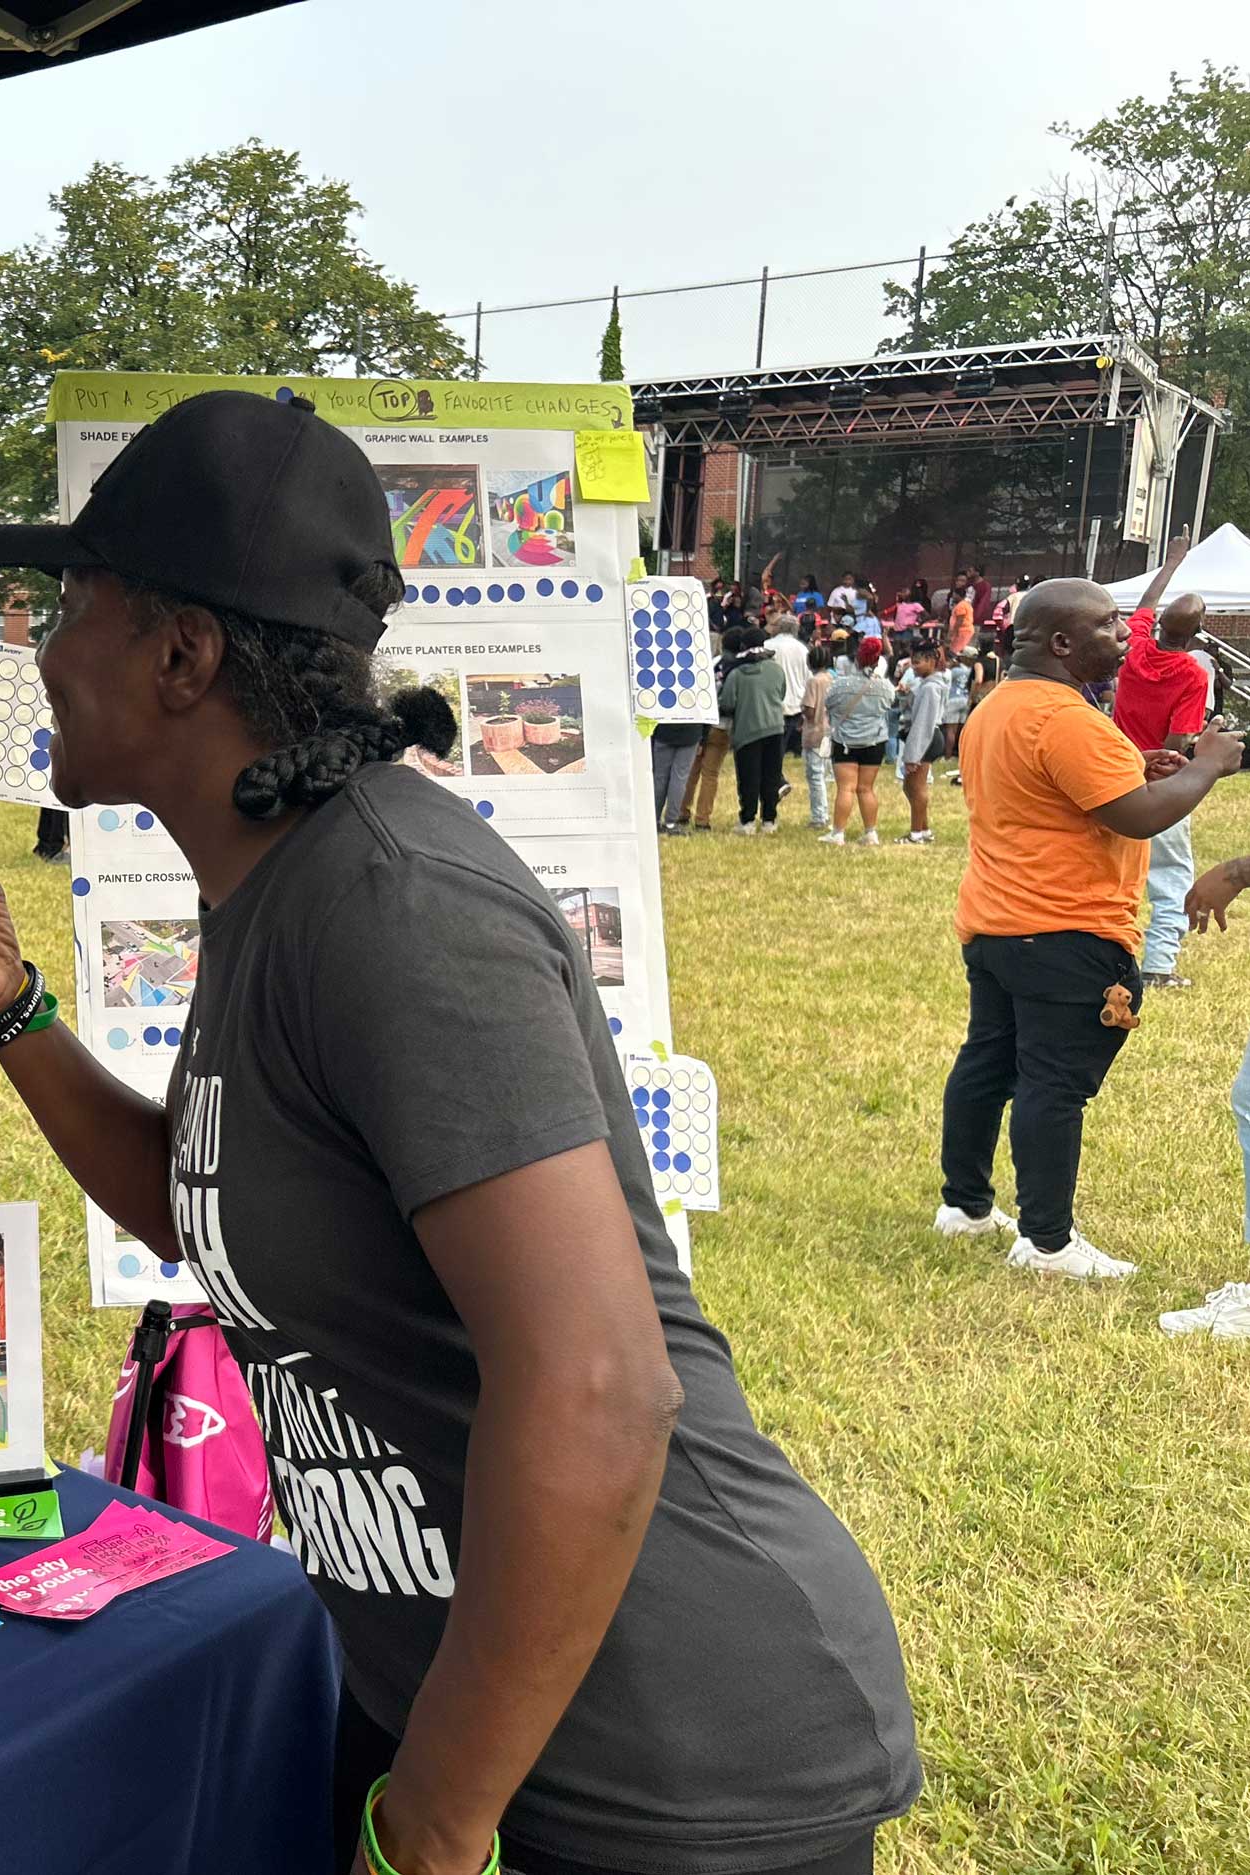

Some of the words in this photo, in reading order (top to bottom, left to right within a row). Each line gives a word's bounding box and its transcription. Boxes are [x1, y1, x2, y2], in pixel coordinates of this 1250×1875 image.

[76, 388, 108, 411] PUT
[124, 389, 132, 409] A
[327, 389, 367, 409] YOUR
[376, 391, 410, 409] TOP
[444, 392, 513, 412] FAVORITE
[526, 397, 611, 416] CHANGES
[80, 431, 118, 442] SHADE
[365, 434, 407, 444] GRAPHIC
[409, 434, 435, 444] WALL
[439, 434, 489, 444] EXAMPLES
[415, 646, 462, 655] PLANTER
[465, 645, 486, 654] BED
[488, 644, 542, 654] EXAMPLES
[98, 873, 143, 883] PAINTED
[30, 1557, 70, 1579] city
[10, 1589, 31, 1602] is
[34, 1565, 95, 1595] yours.
